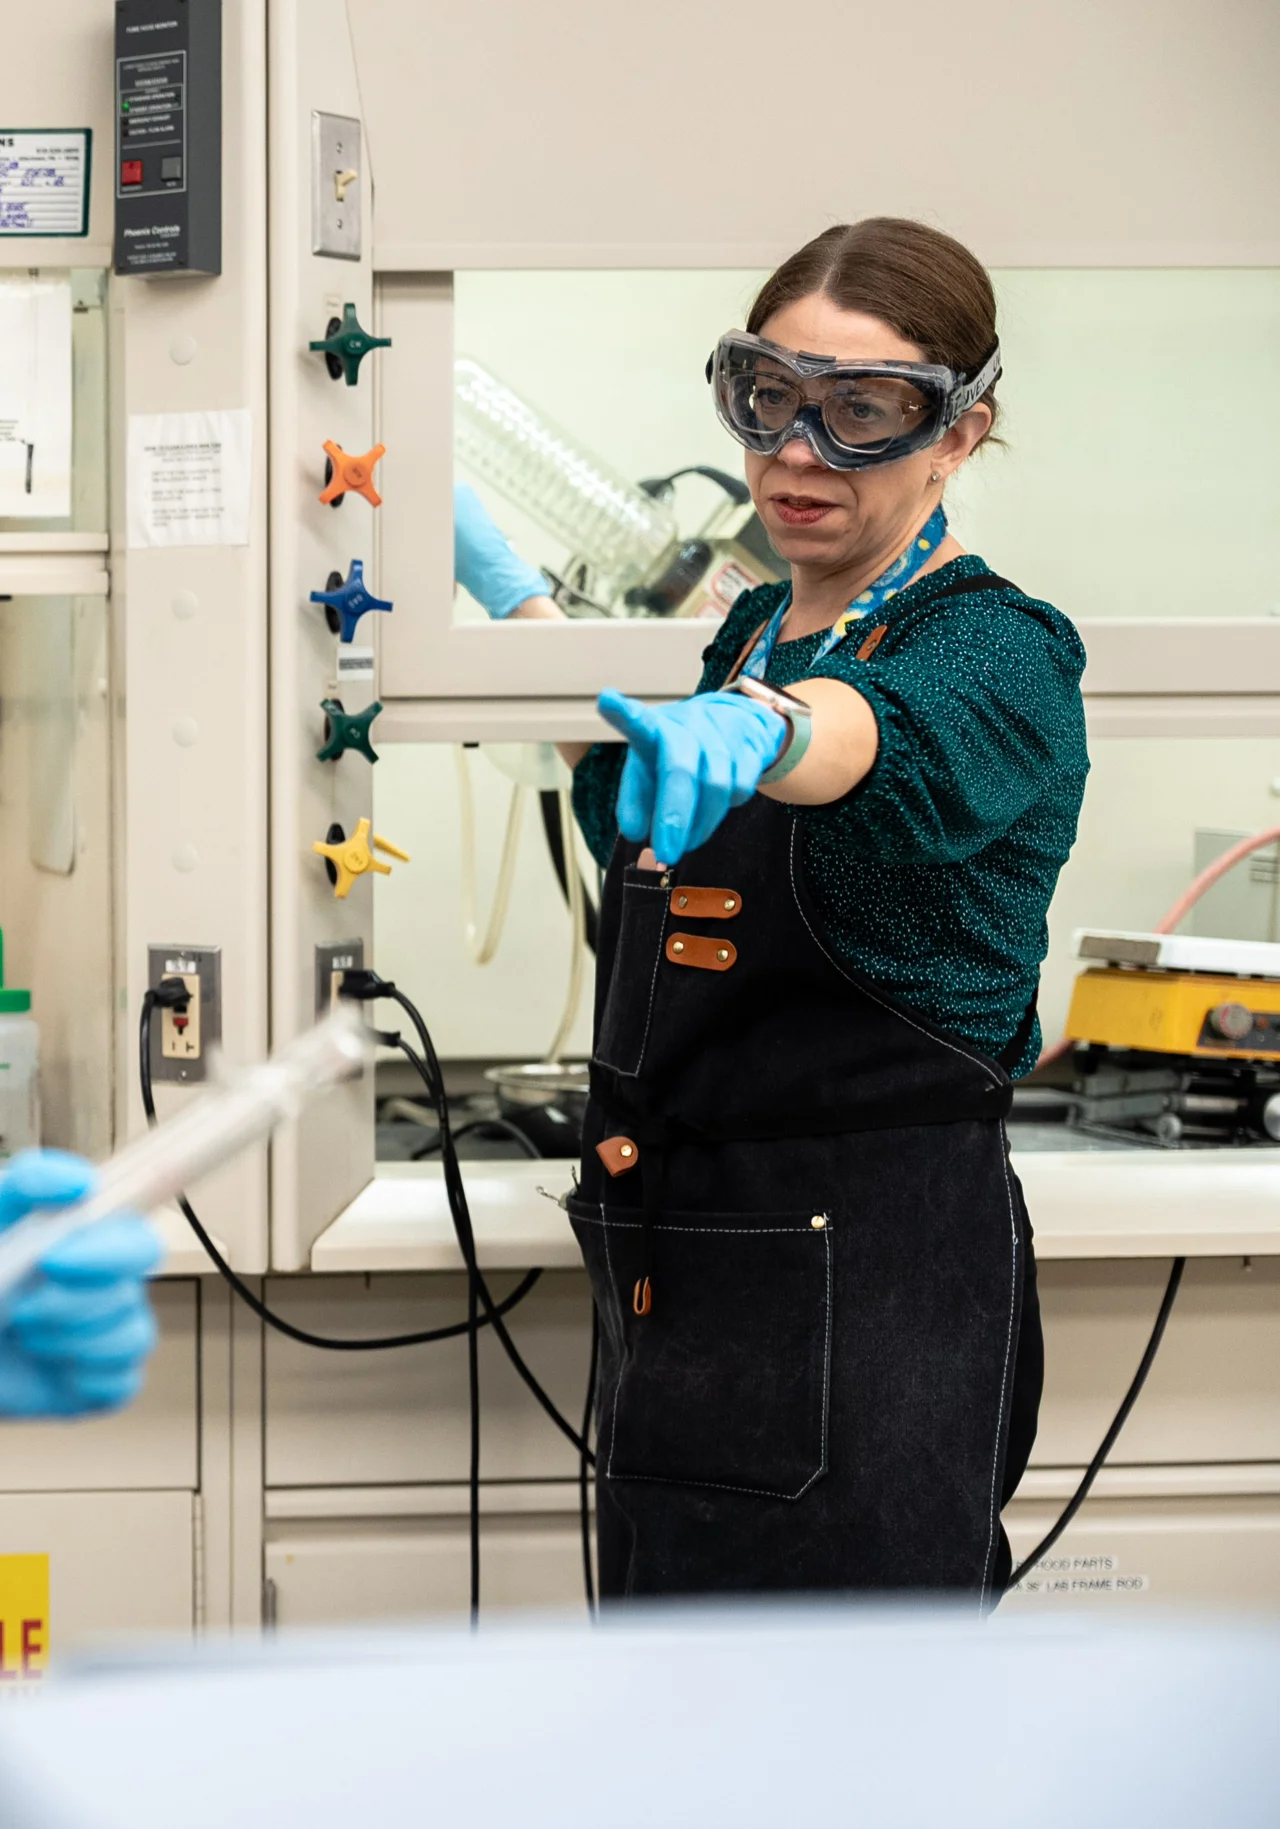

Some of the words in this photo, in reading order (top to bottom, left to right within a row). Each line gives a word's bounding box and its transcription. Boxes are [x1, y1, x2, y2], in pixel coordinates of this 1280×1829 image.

[1073, 1556, 1113, 1570] PARTS
[1047, 1580, 1068, 1592] LAB
[1072, 1578, 1113, 1591] FRAME
[1116, 1576, 1143, 1590] ROD
